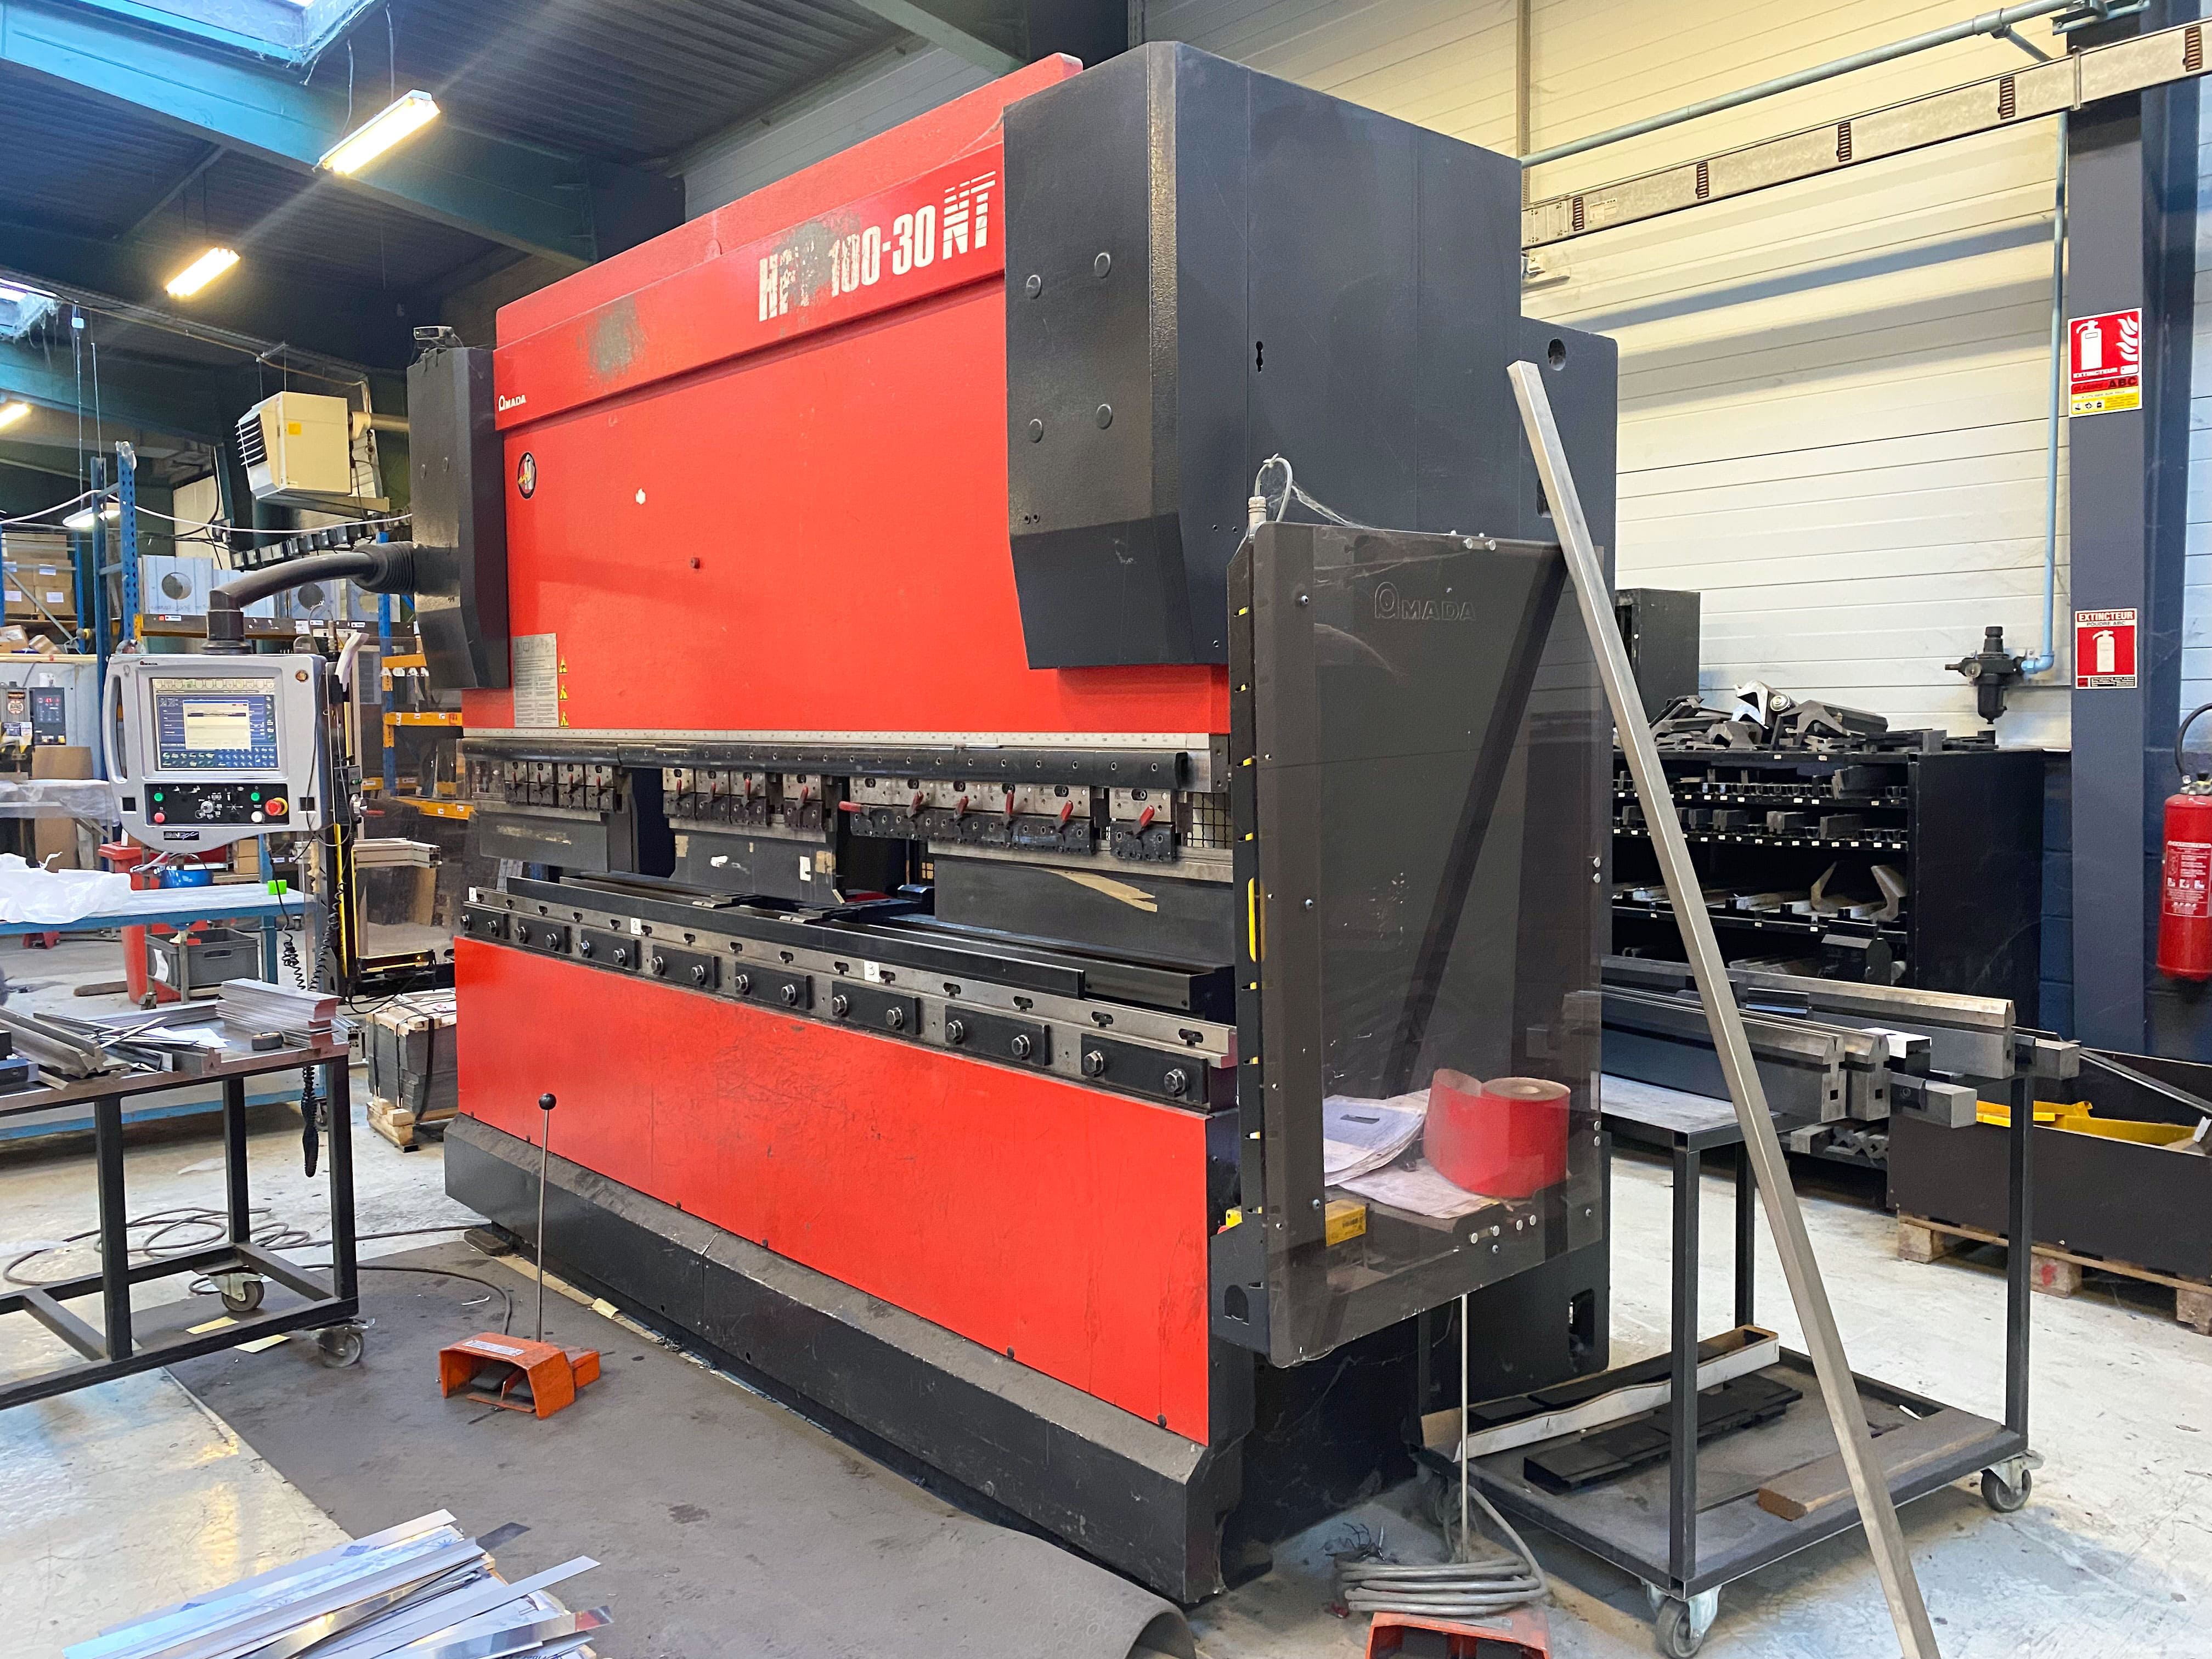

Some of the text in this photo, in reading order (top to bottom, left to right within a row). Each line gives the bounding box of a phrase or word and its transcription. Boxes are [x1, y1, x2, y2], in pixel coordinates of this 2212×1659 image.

[2108, 377, 2137, 388] ABC
[2078, 611, 2134, 621] EXTINCTEUR
[633, 921, 638, 930] 2
[868, 963, 875, 975] 3
